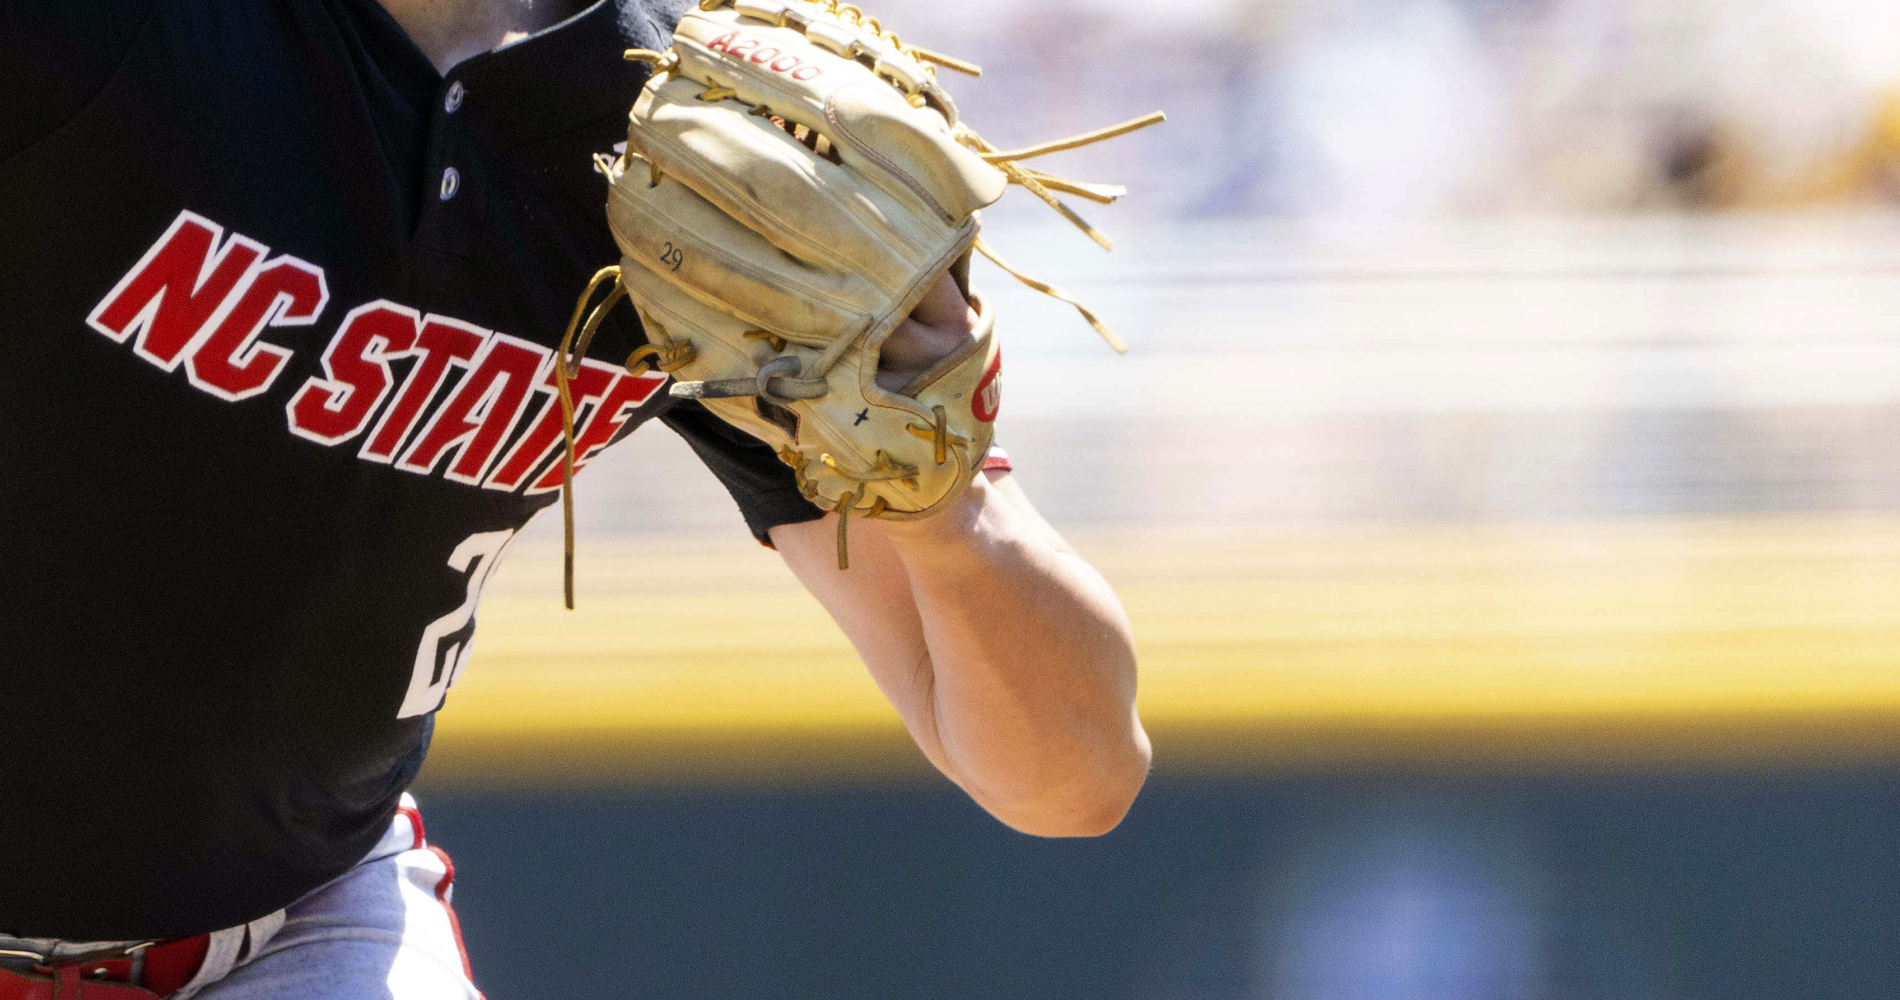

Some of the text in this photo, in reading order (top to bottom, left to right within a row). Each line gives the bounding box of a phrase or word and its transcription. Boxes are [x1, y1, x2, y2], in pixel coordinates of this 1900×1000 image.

[706, 31, 822, 81] A2000
[660, 241, 683, 272] 29
[86, 209, 670, 496] NC STATE
